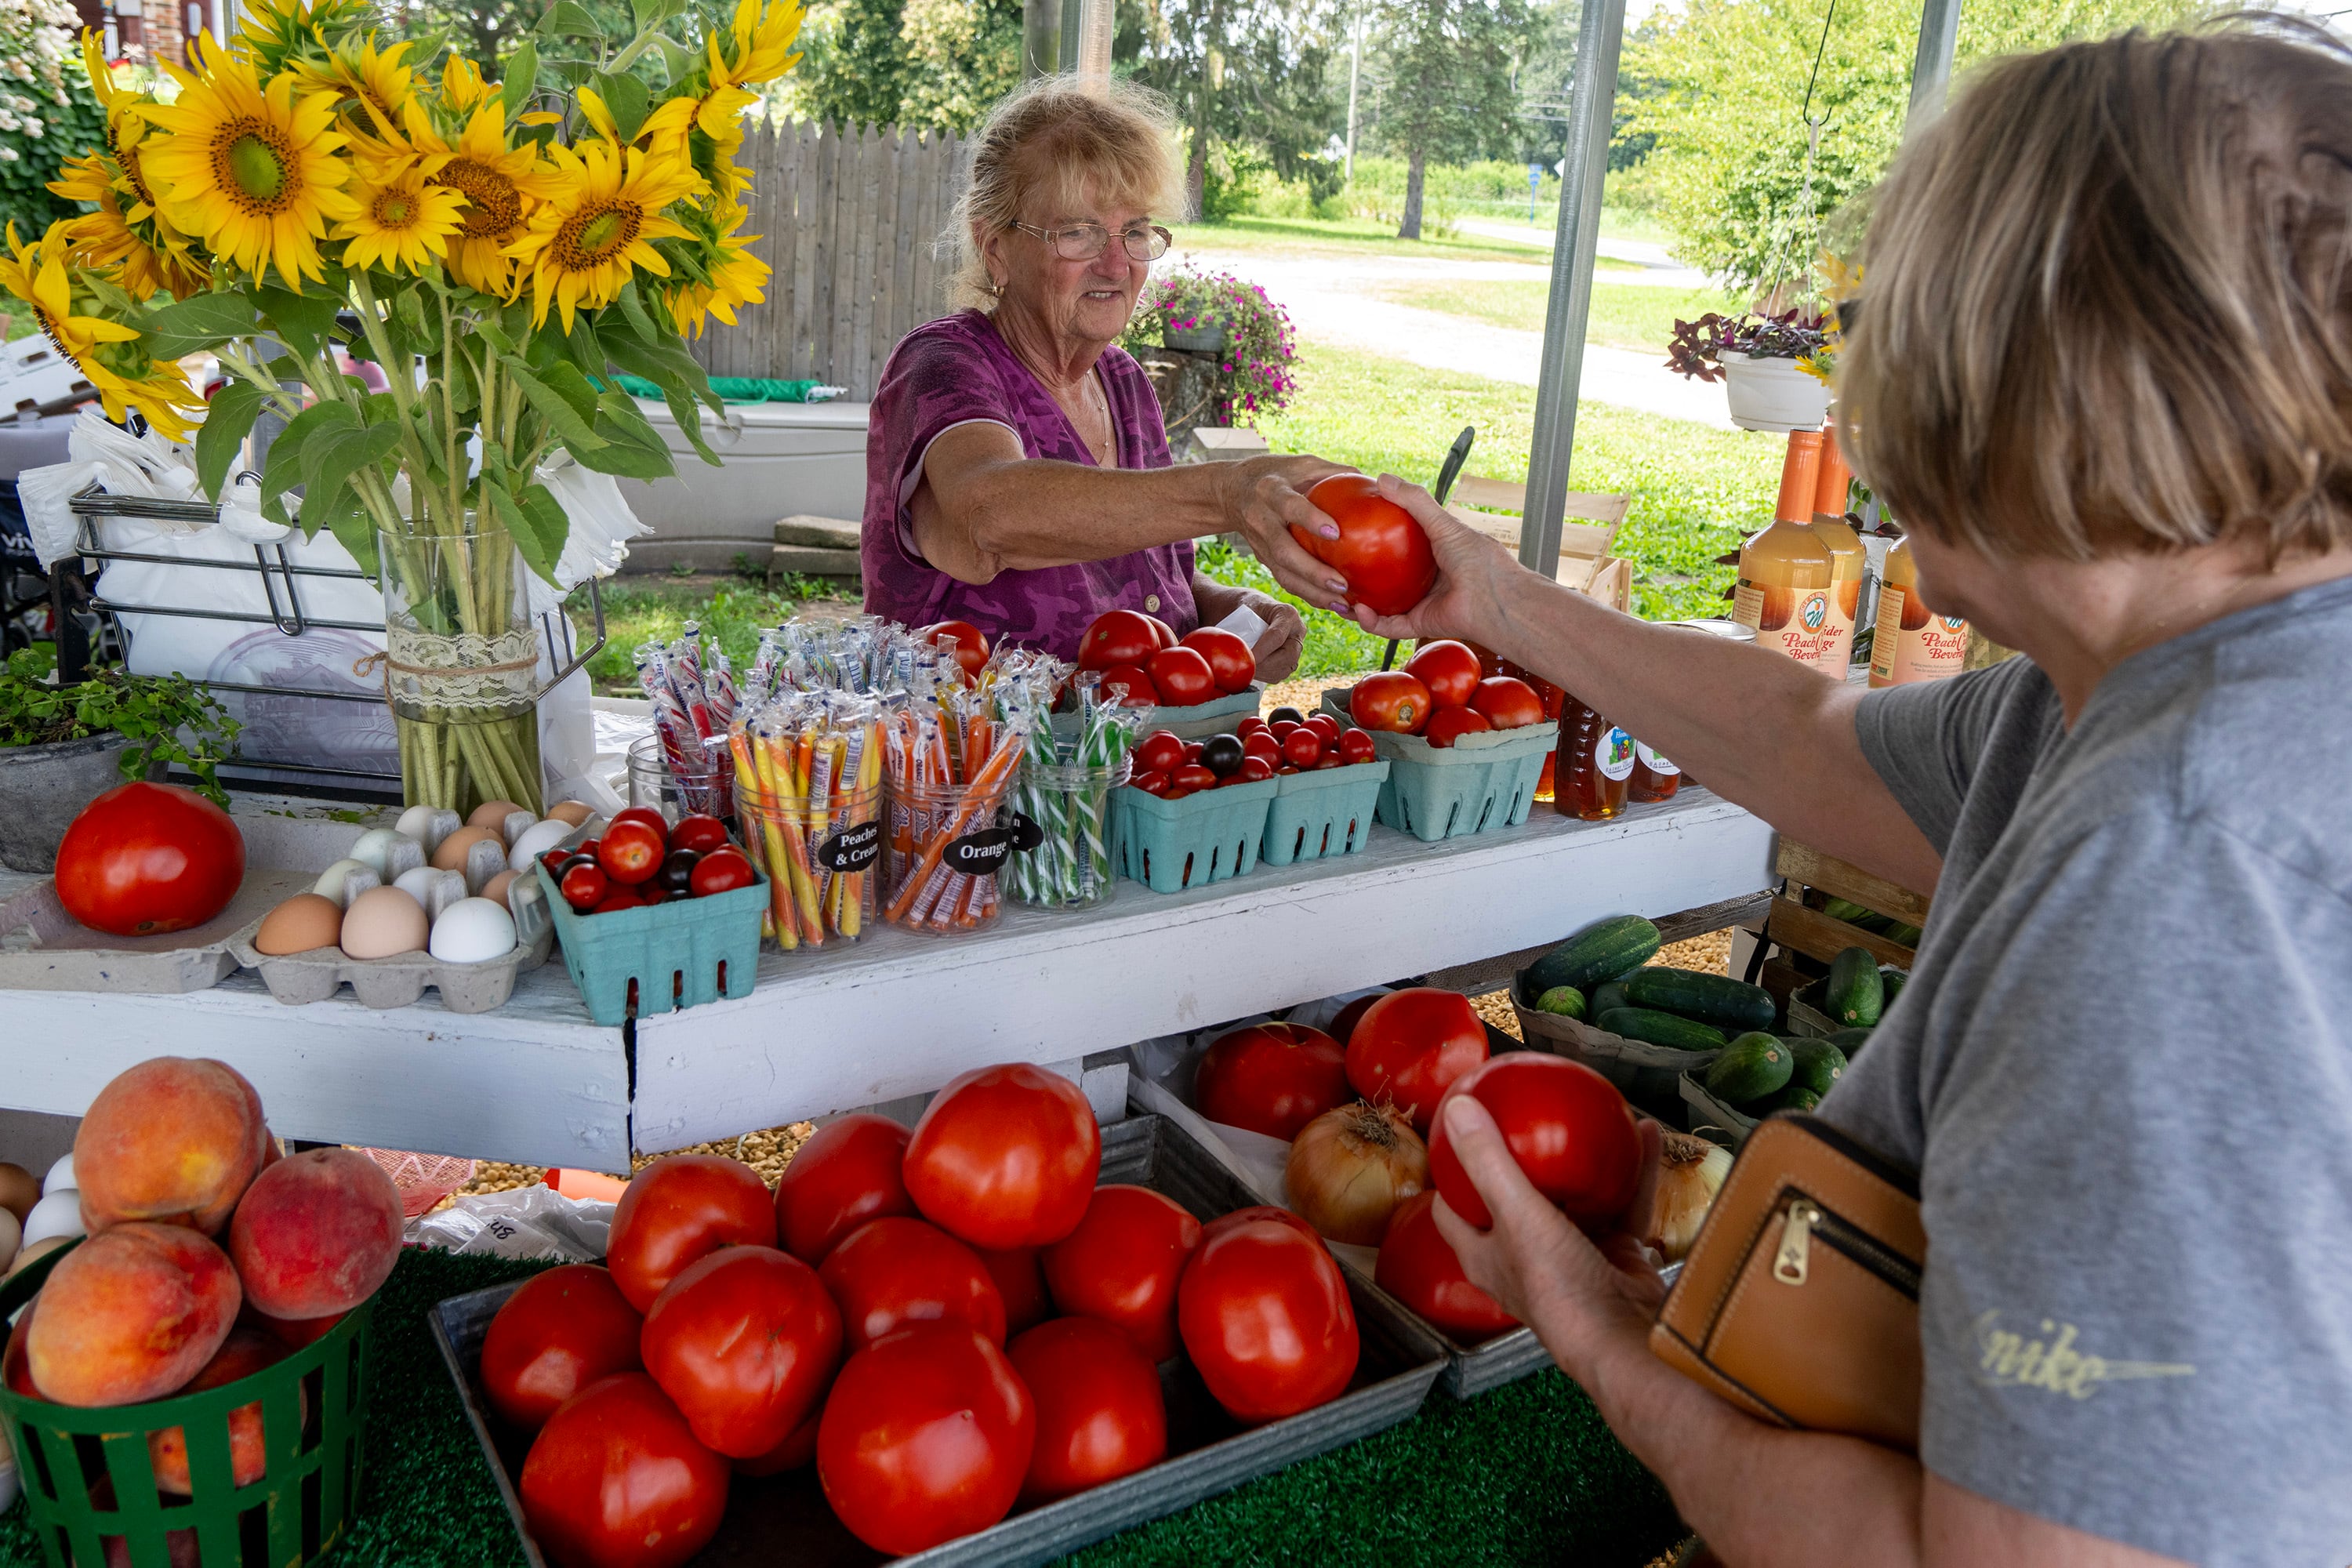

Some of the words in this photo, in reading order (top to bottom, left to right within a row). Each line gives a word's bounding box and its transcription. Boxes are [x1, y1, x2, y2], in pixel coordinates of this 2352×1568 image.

[1824, 626, 1843, 637] ider
[1782, 633, 1816, 648] Peach
[1922, 633, 1957, 648] Peach
[840, 827, 877, 847] Peaches
[836, 853, 848, 866] &
[851, 843, 878, 862] Cream
[960, 841, 1007, 858] Orange
